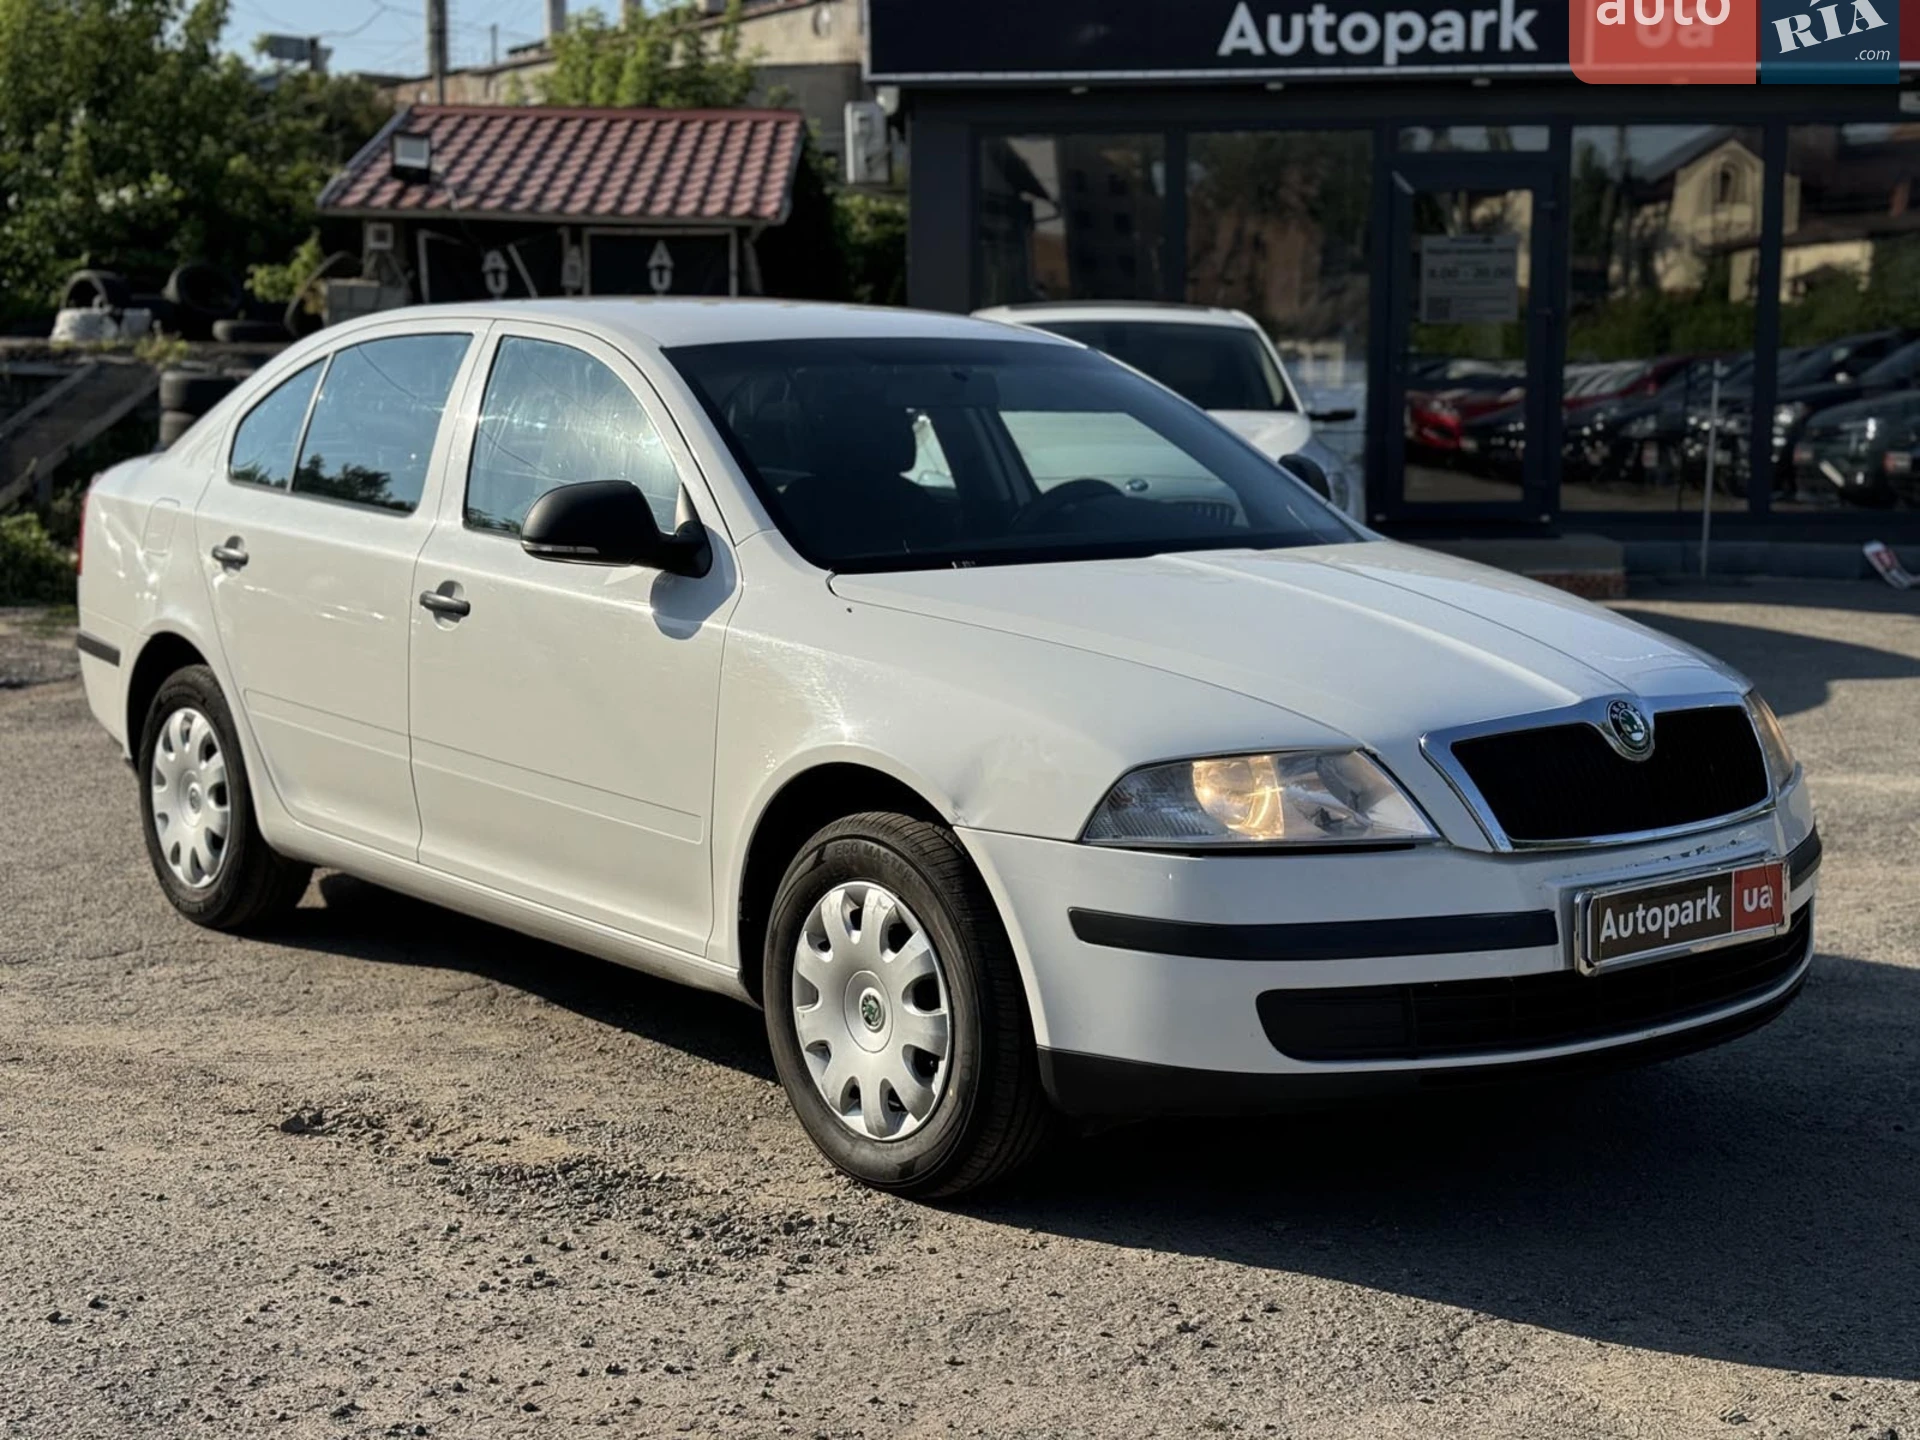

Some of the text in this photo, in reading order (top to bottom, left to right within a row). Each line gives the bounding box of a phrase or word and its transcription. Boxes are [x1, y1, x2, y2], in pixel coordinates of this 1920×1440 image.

[1217, 0, 1538, 66] Autopark
[1600, 884, 1774, 942] Autopark ua
